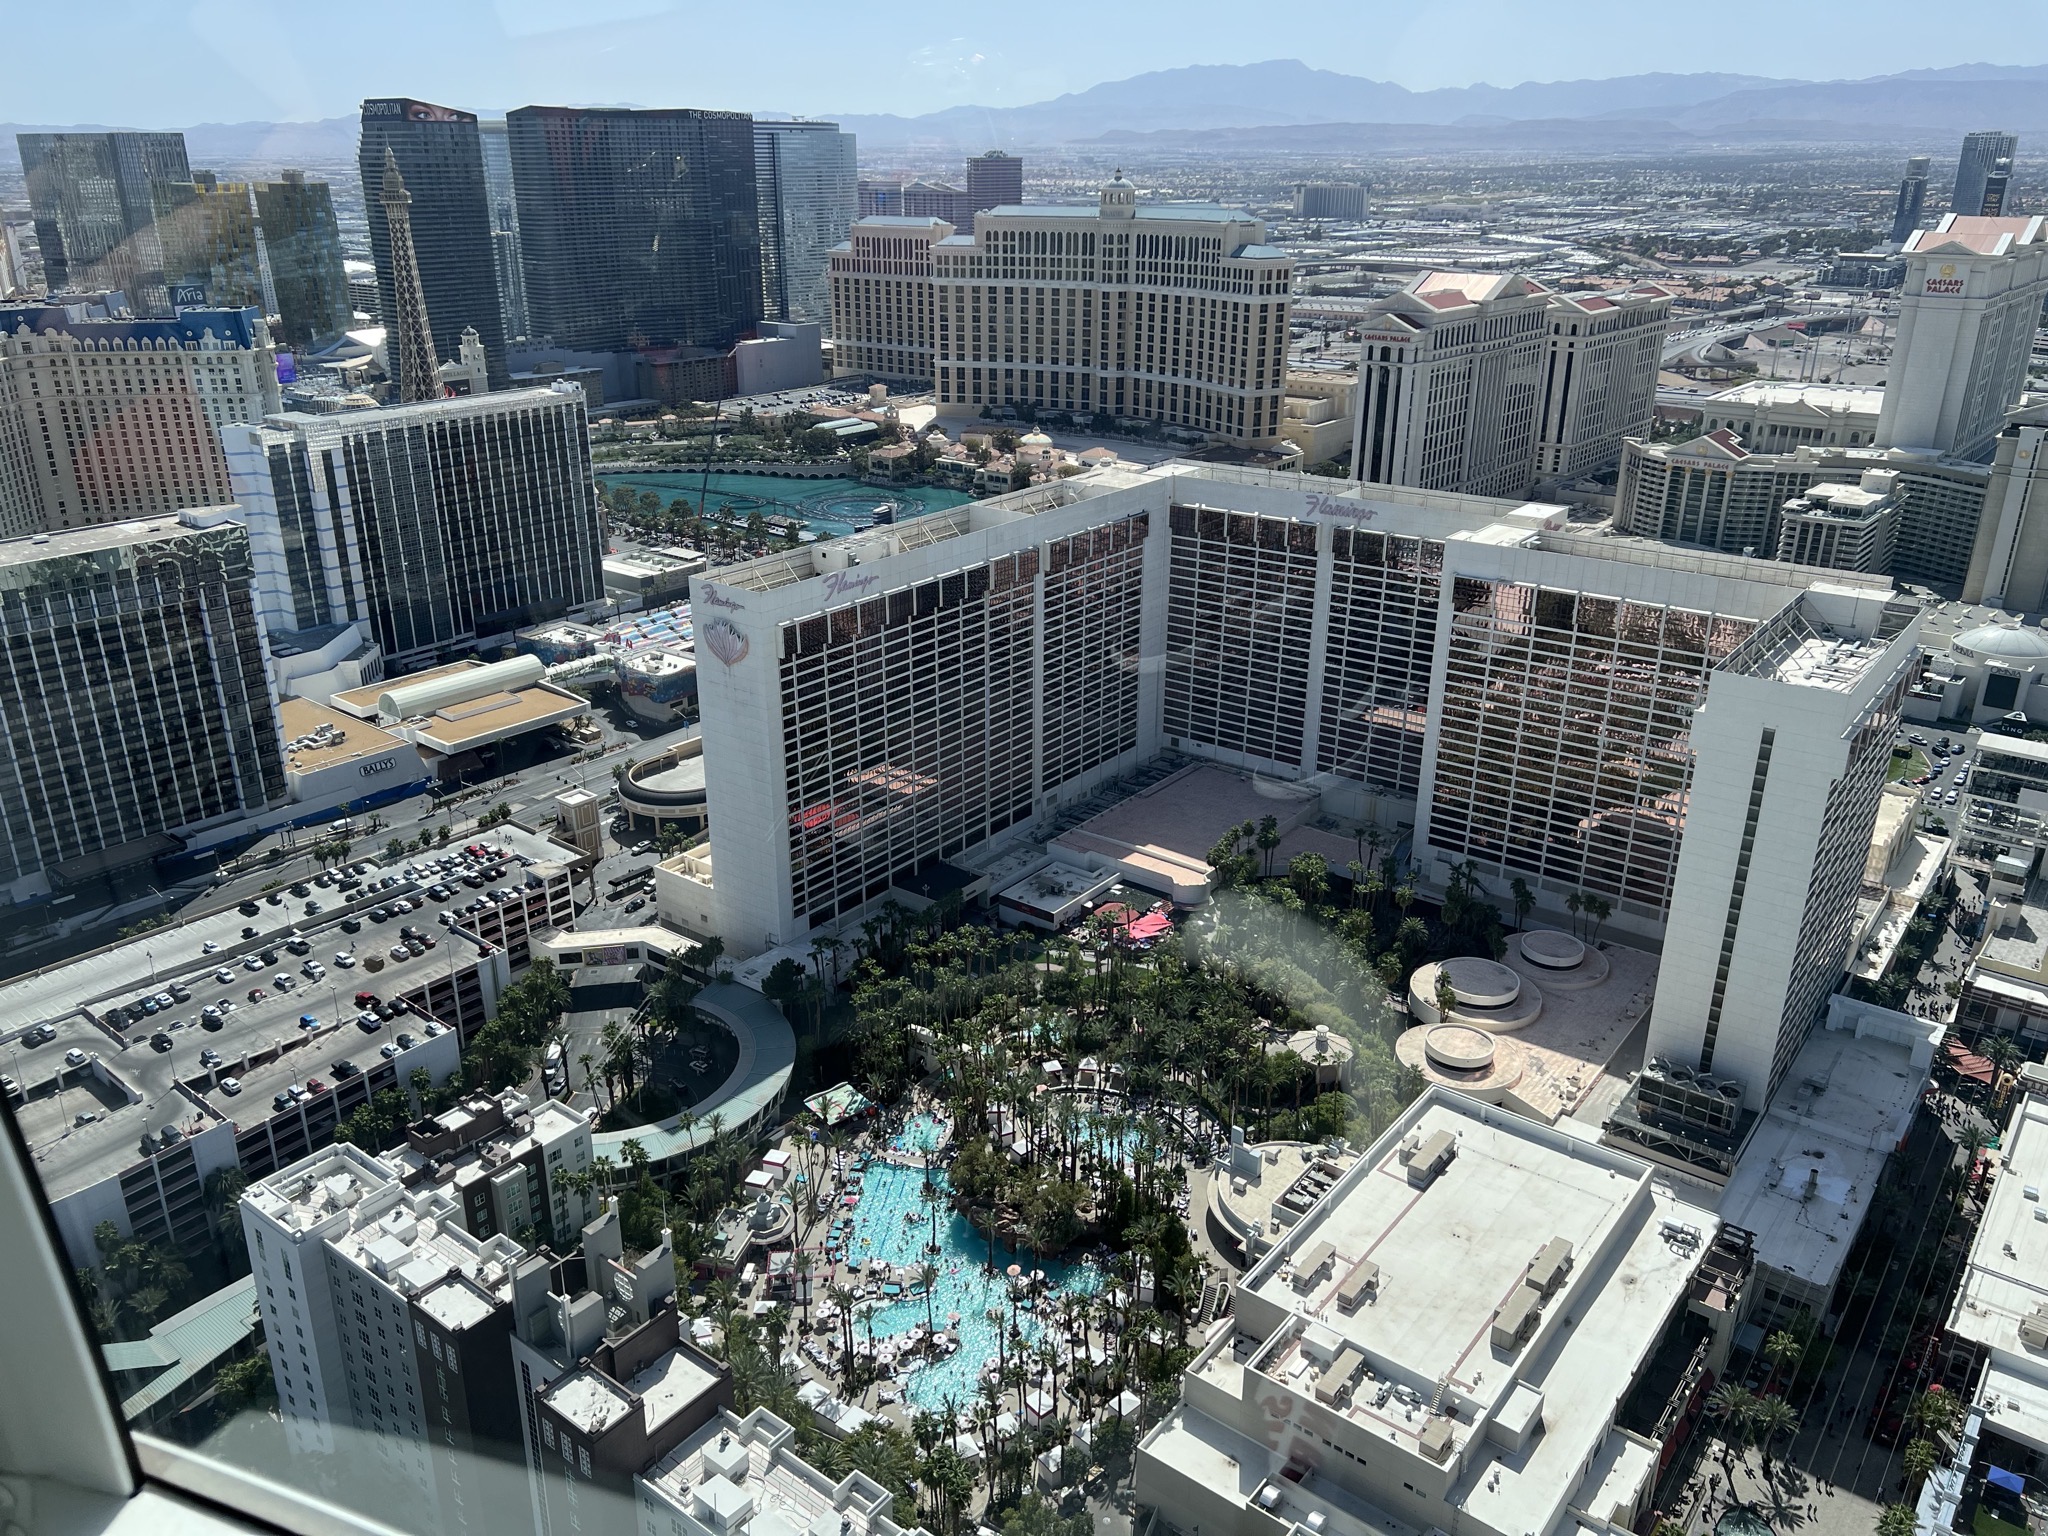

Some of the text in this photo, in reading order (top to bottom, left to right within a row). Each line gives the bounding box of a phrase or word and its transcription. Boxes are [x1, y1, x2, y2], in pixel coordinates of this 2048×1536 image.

[688, 110, 752, 120] THE COSMOPOLITAN
[1926, 278, 1964, 287] CAESARS
[177, 287, 203, 303] Aria
[1926, 286, 1961, 294] PALACE
[1364, 333, 1389, 341] CAESARS
[1671, 458, 1729, 470] CAESARS PALACE
[1305, 494, 1379, 526] Flamingo
[822, 571, 879, 602] Flamingo
[701, 583, 745, 614] Flamingo
[1952, 642, 1974, 658] OMNIA
[1990, 666, 2022, 679] OMNIA
[2001, 725, 2023, 734] LINQ
